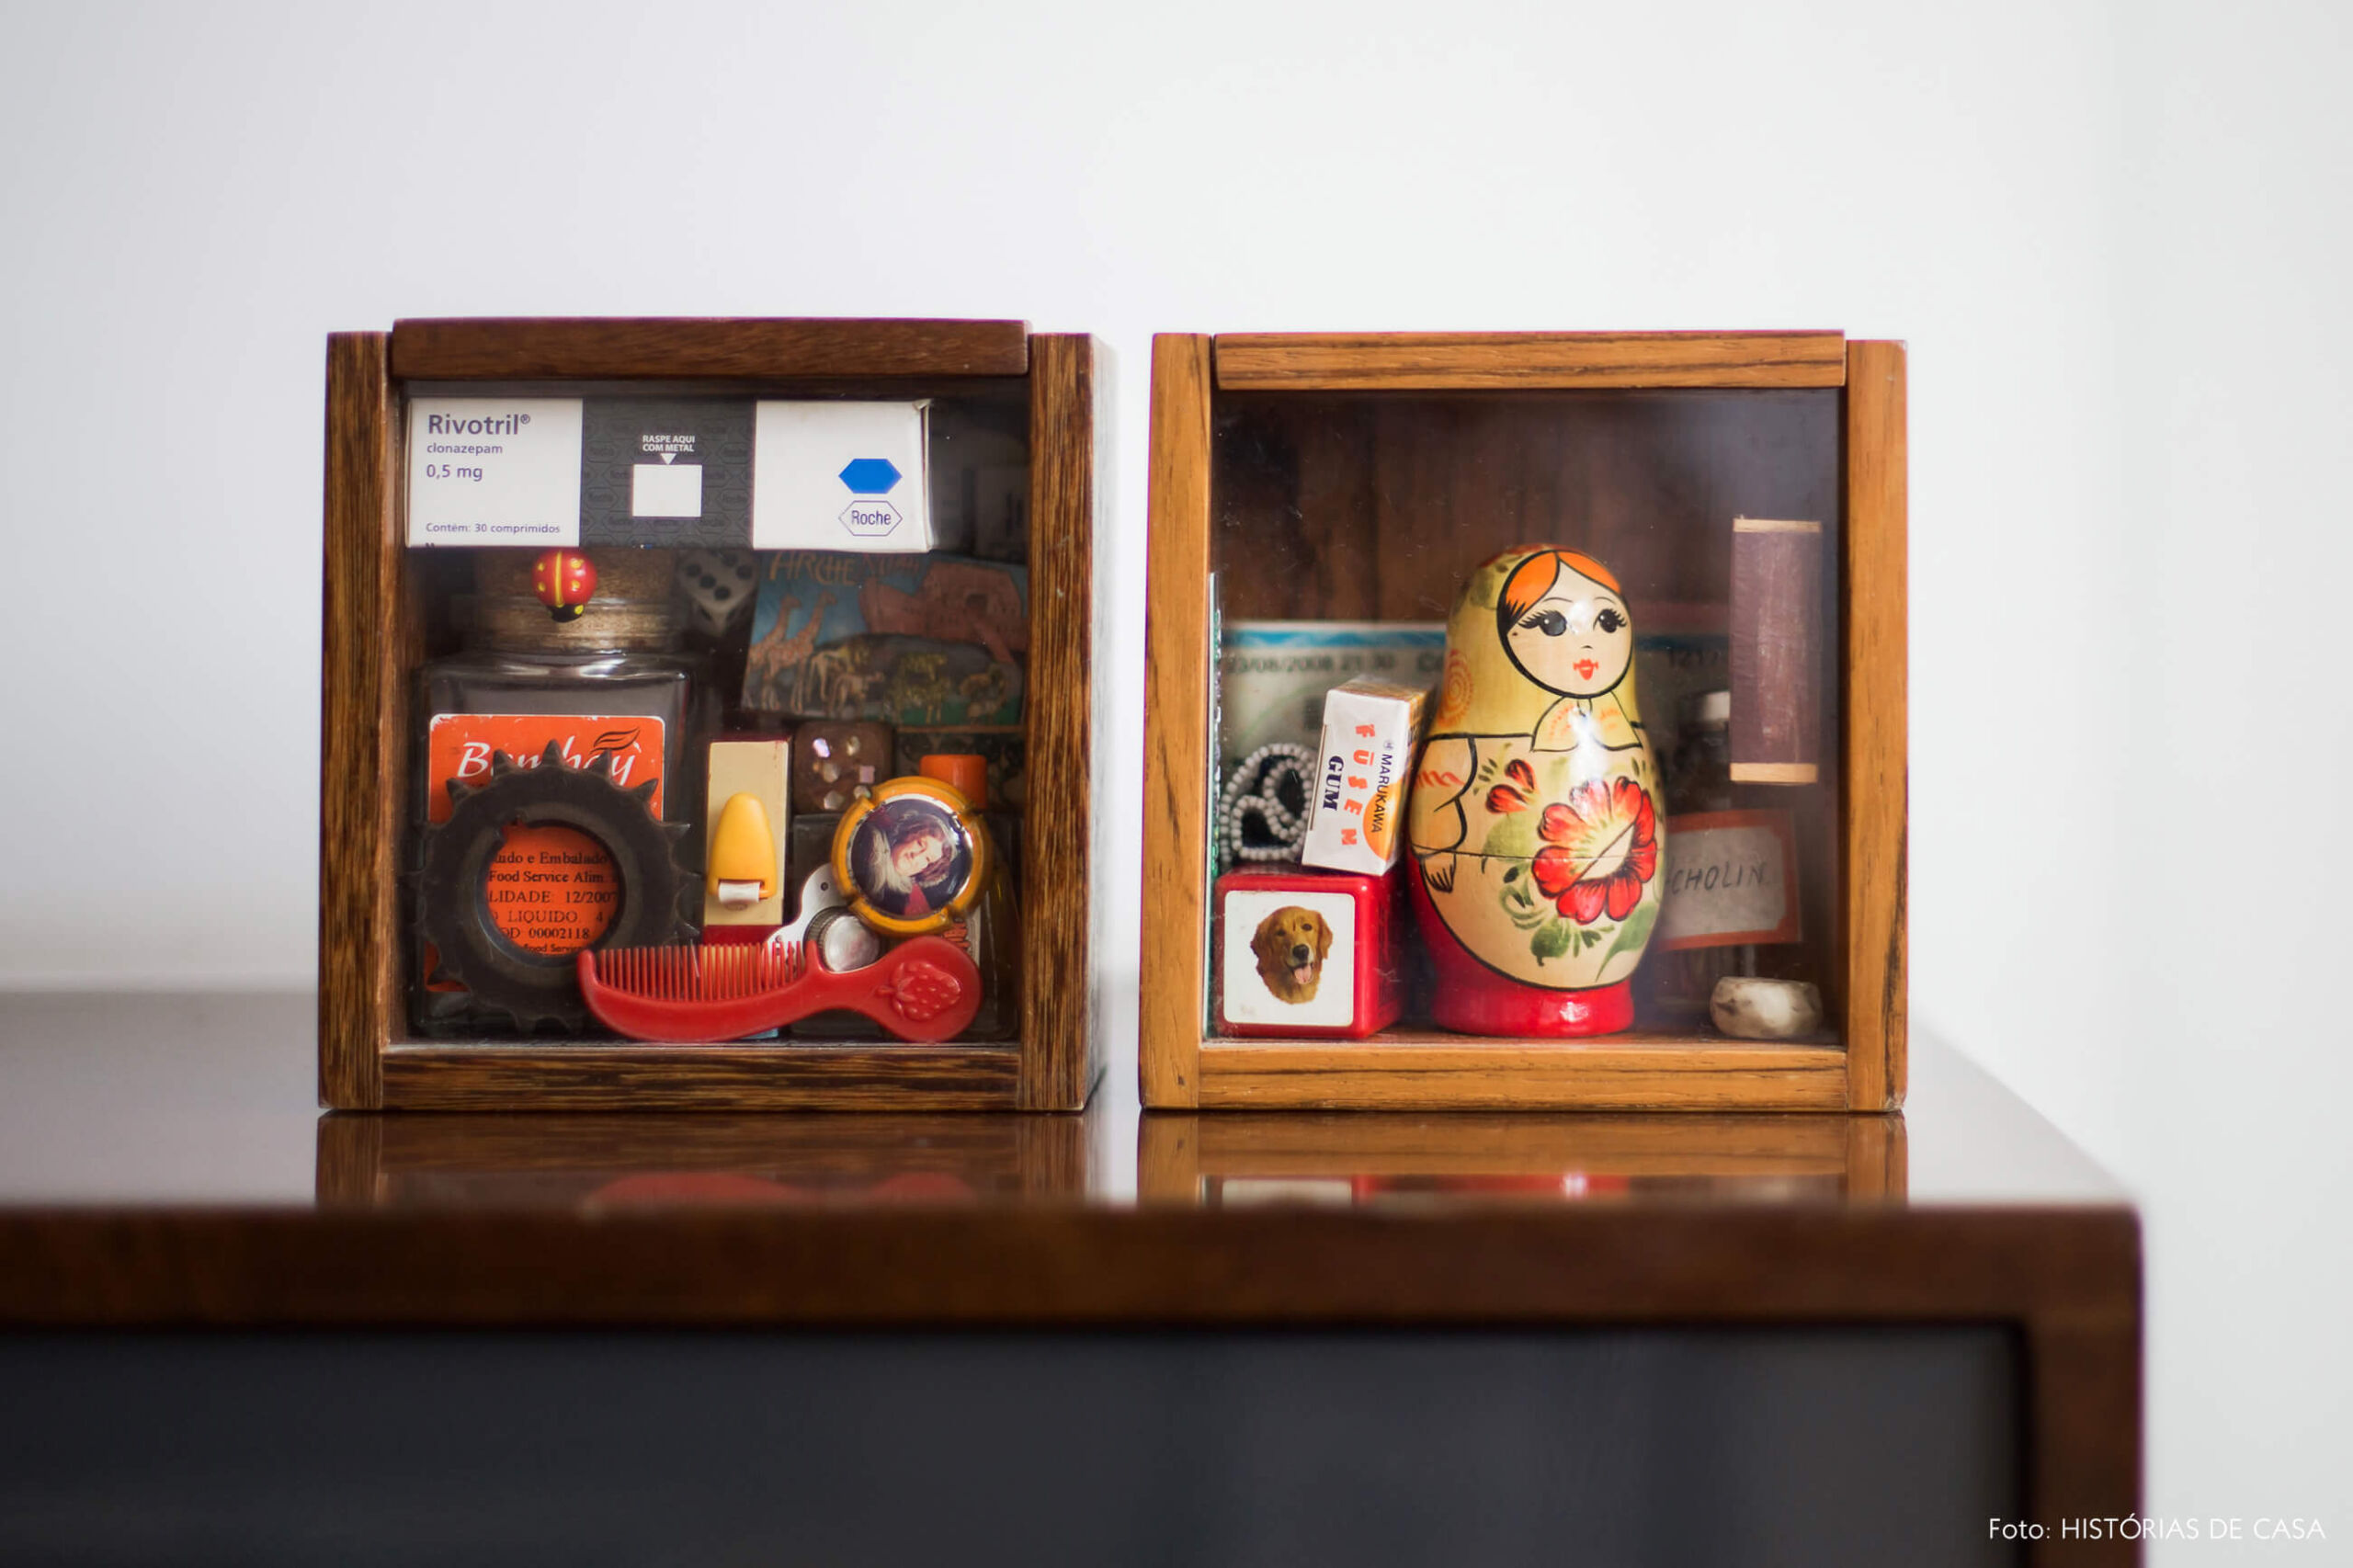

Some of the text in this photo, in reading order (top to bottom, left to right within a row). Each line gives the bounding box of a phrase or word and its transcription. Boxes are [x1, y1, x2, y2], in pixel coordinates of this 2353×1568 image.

[642, 435, 696, 444] RASPE AQUI
[426, 443, 503, 456] clonazepam
[642, 443, 695, 452] COM METAL
[426, 464, 483, 482] 0,5 mg
[851, 510, 892, 526] Roche
[426, 523, 561, 535] Contém: 30 comprimidos
[1323, 755, 1344, 812] GUM
[1370, 754, 1393, 834] MARUKAWA
[528, 854, 535, 864] e
[489, 870, 520, 882] Food
[523, 870, 569, 882] Service
[1666, 859, 1768, 895] CHOLIN
[529, 927, 590, 938] 00002118
